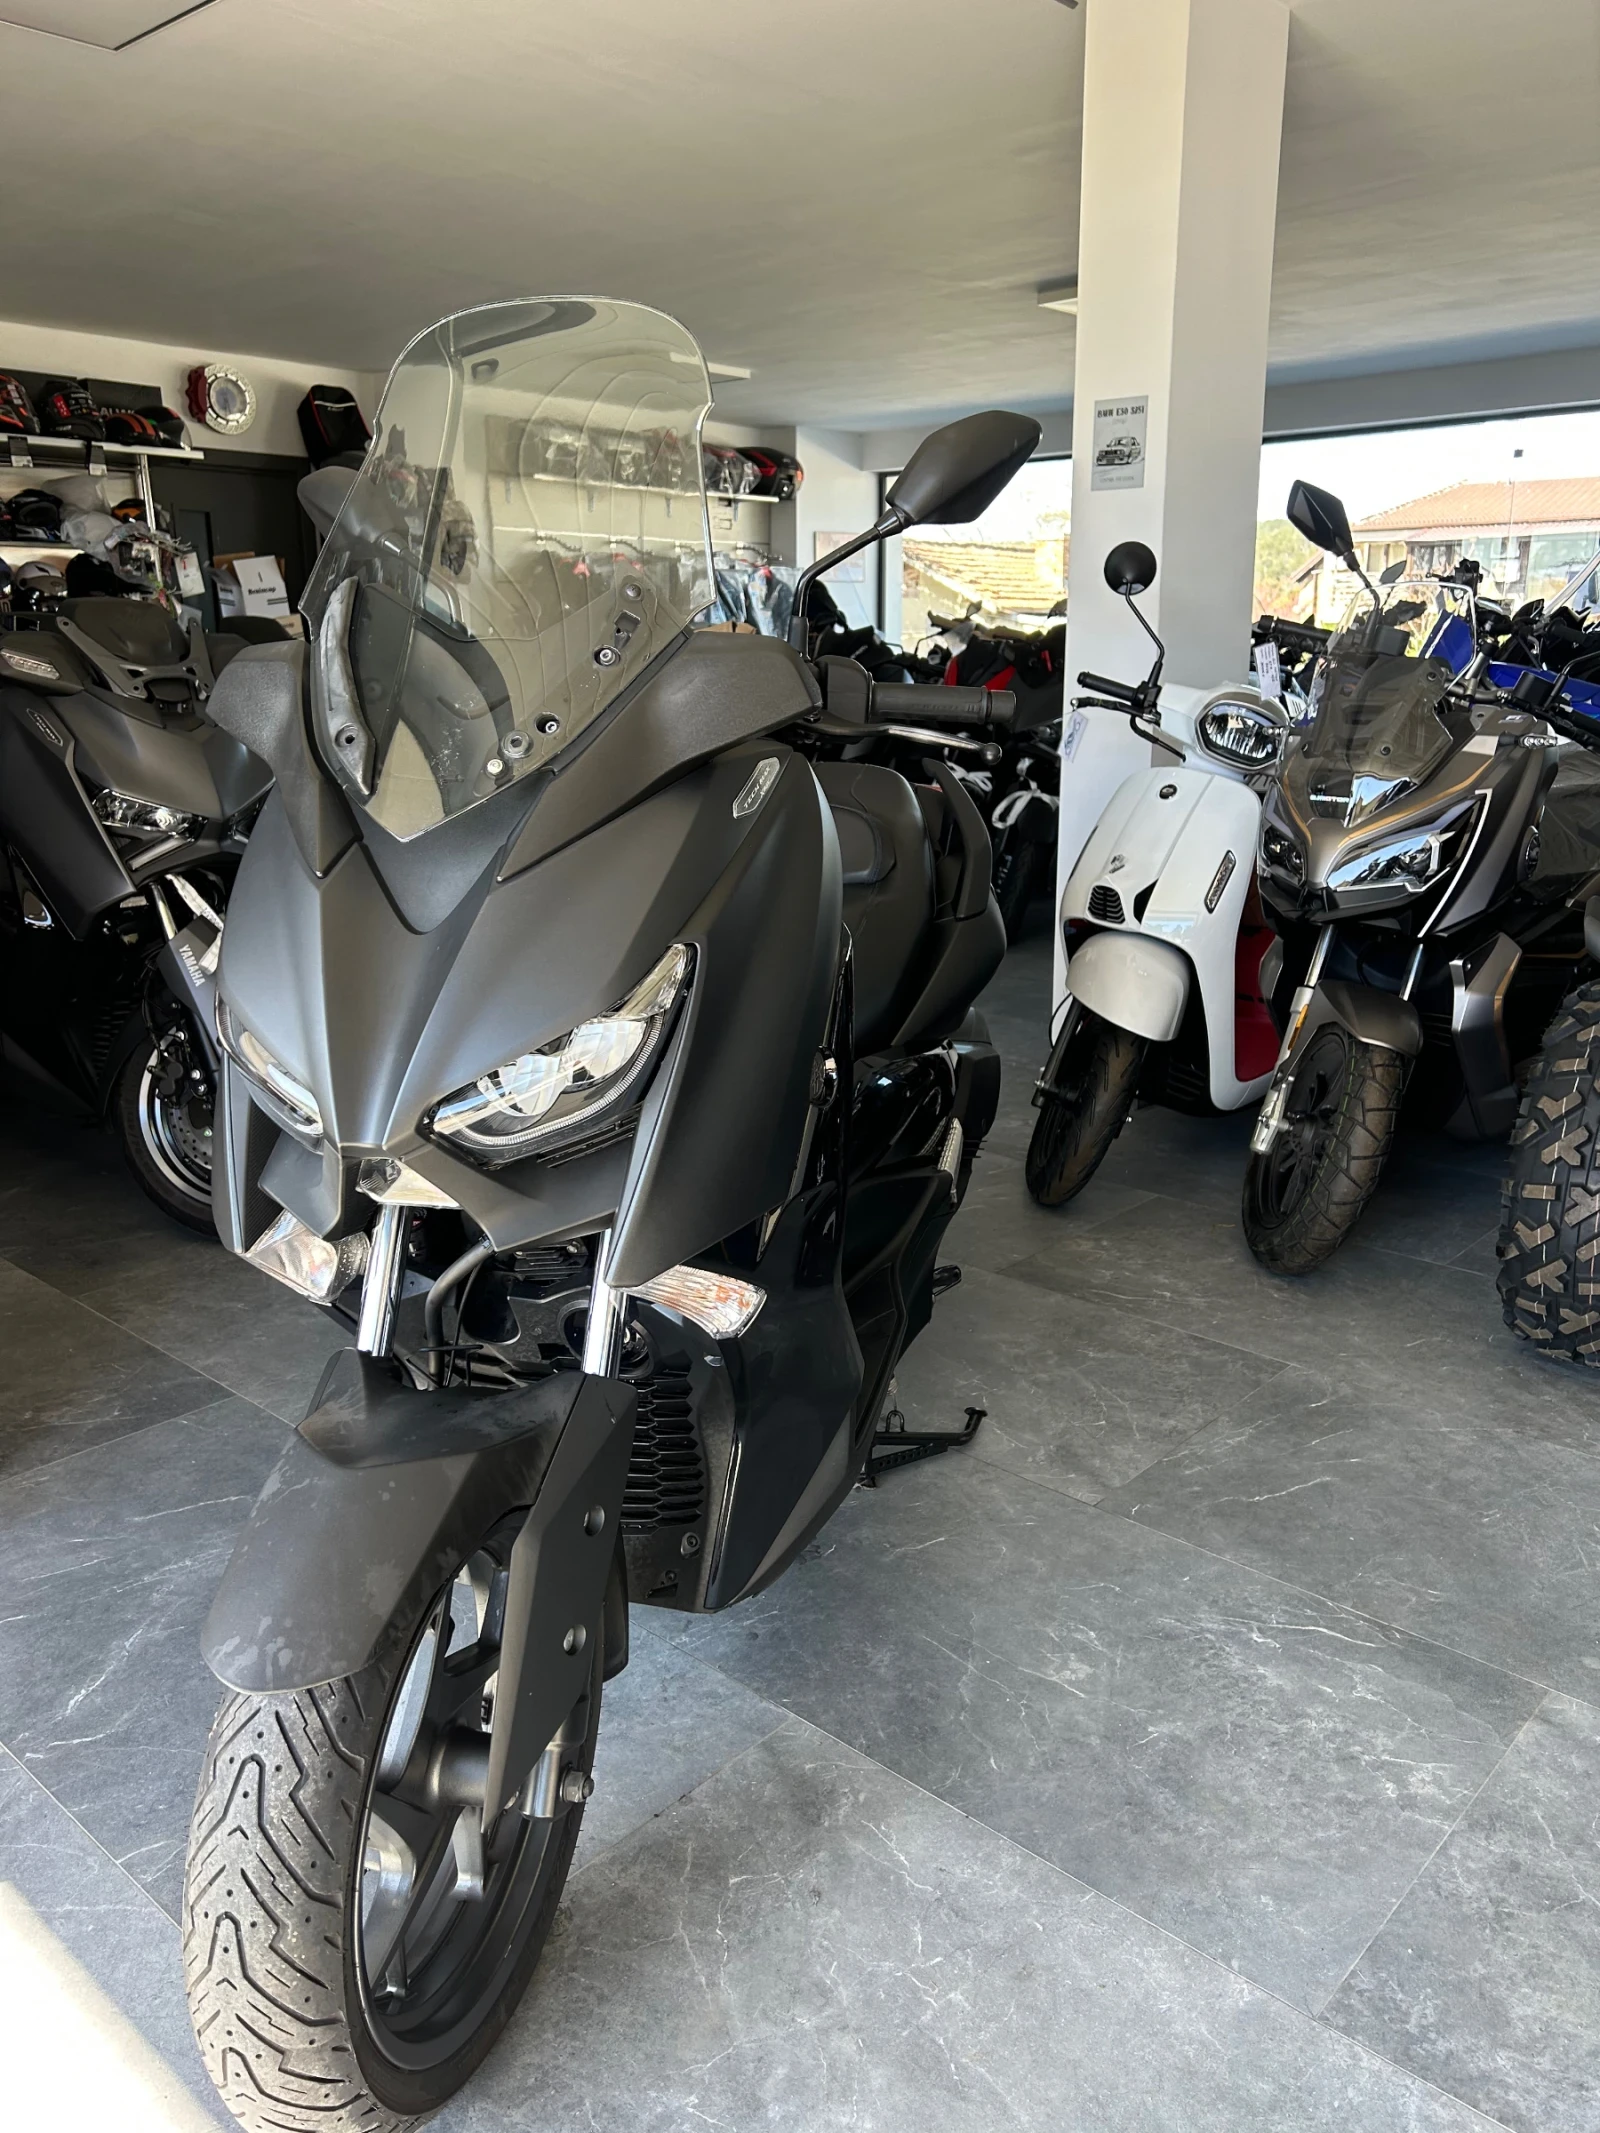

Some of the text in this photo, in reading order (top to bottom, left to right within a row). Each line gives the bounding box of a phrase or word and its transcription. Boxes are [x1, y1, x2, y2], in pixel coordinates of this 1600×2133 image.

[1116, 407, 1129, 417] E30
[743, 783, 760, 809] TECH
[179, 944, 206, 987] YAMAHA
